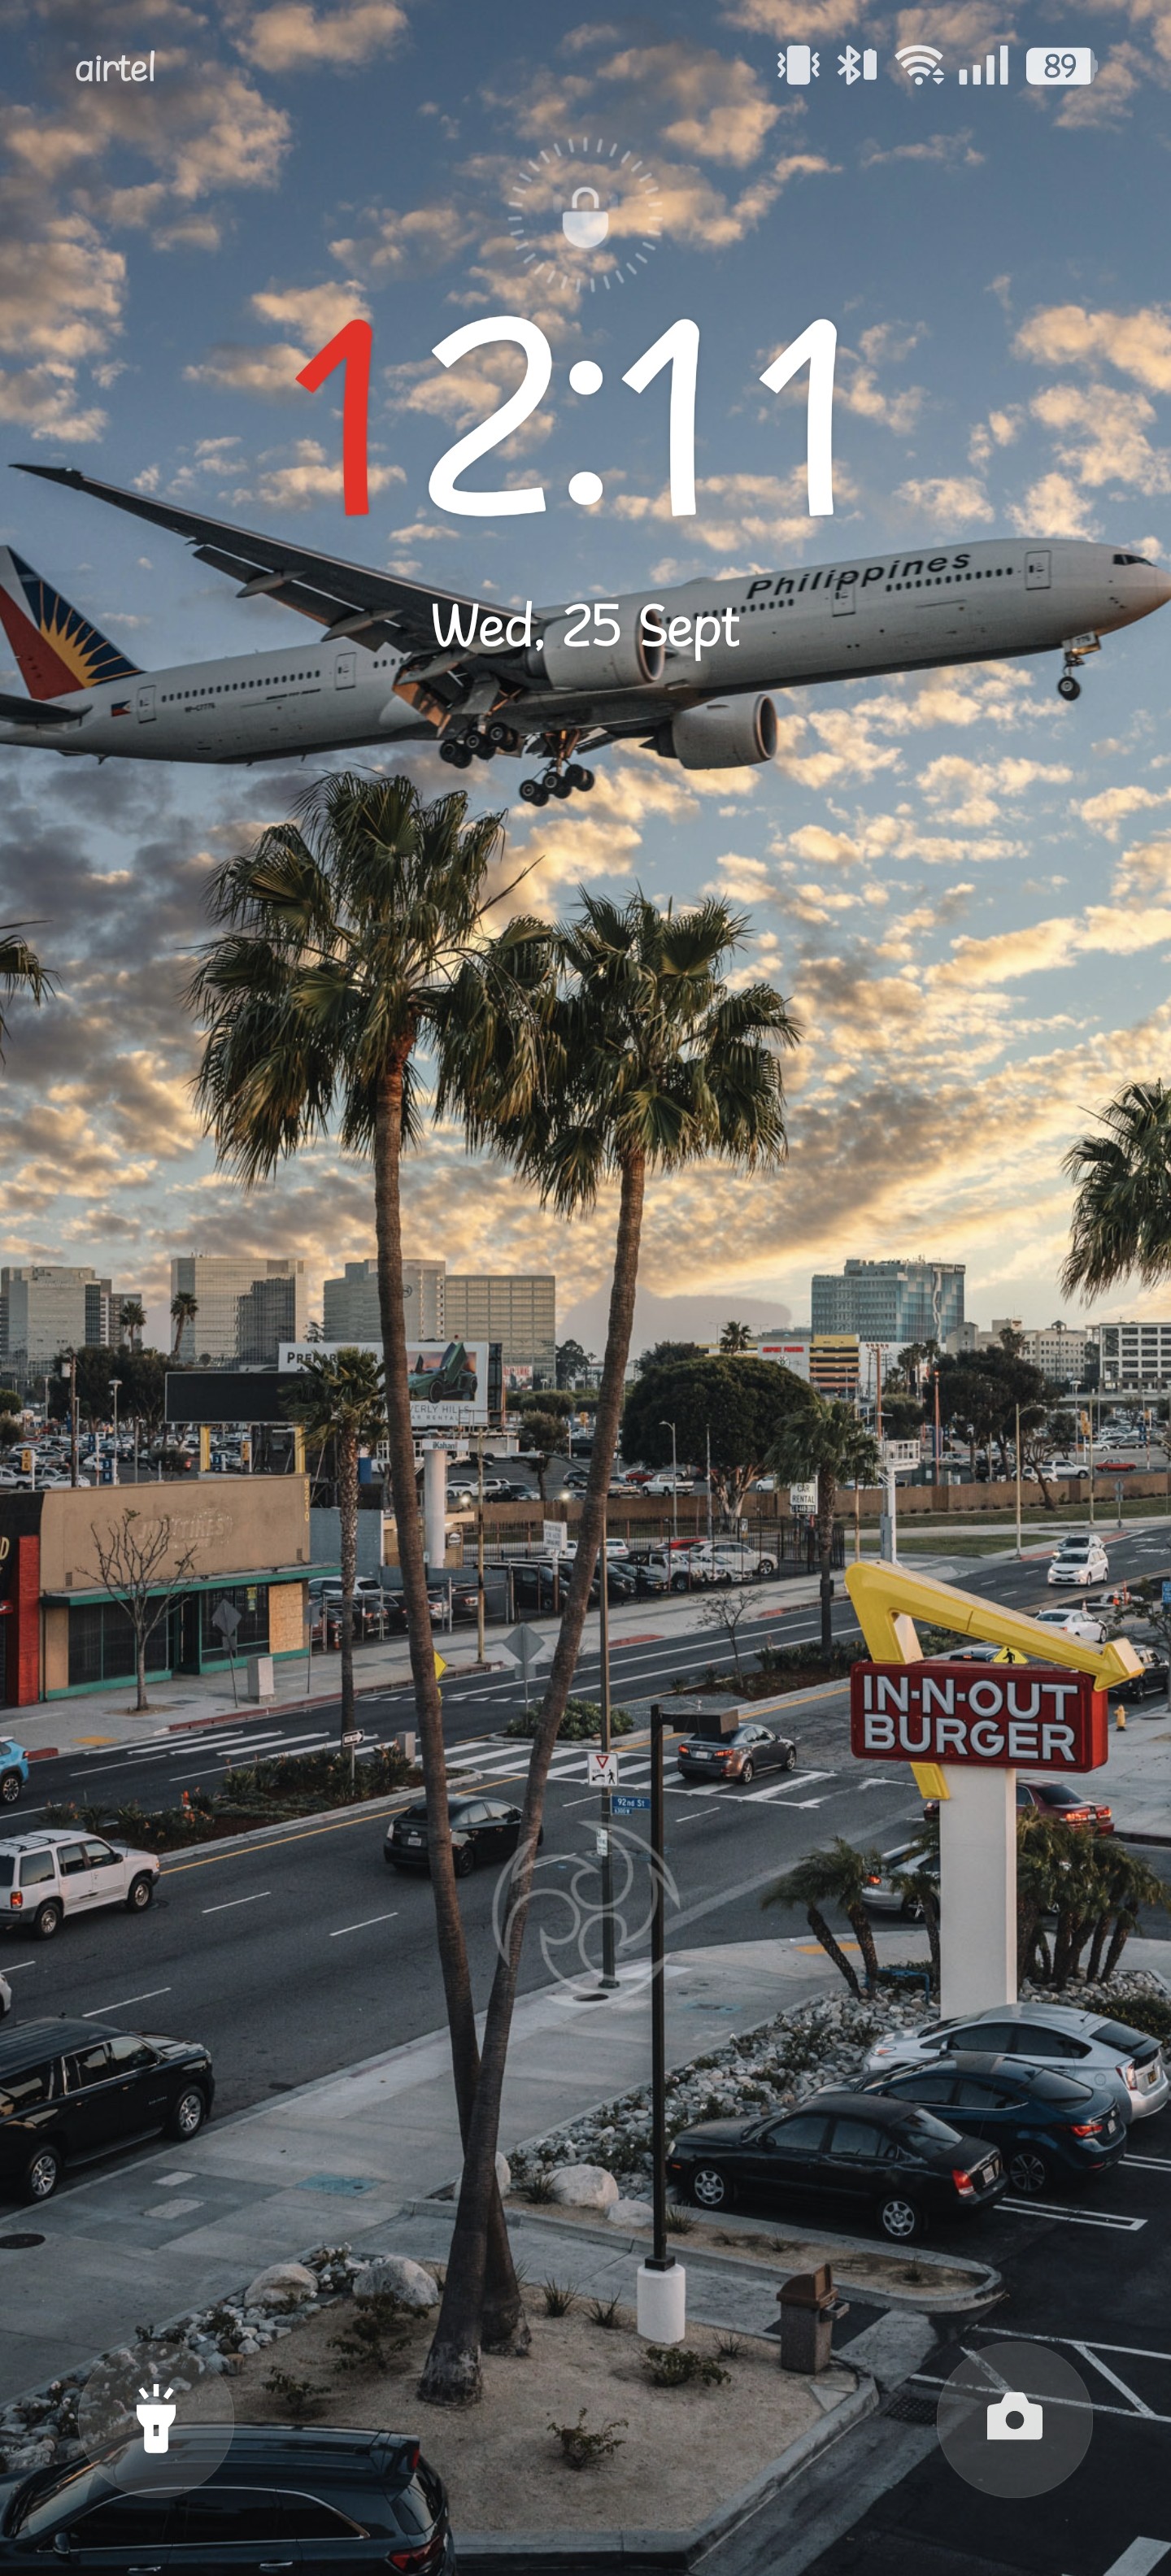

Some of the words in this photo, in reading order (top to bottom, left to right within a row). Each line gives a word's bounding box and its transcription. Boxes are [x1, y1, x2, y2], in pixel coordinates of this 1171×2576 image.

[746, 553, 972, 600] Philippines
[792, 1495, 815, 1503] RENTAL
[797, 1484, 811, 1493] CAR
[863, 1673, 1078, 1721] IN-N-OUT
[864, 1712, 1077, 1762] BURGER
[618, 1798, 634, 1807] 92nd
[637, 1799, 645, 1808] St
